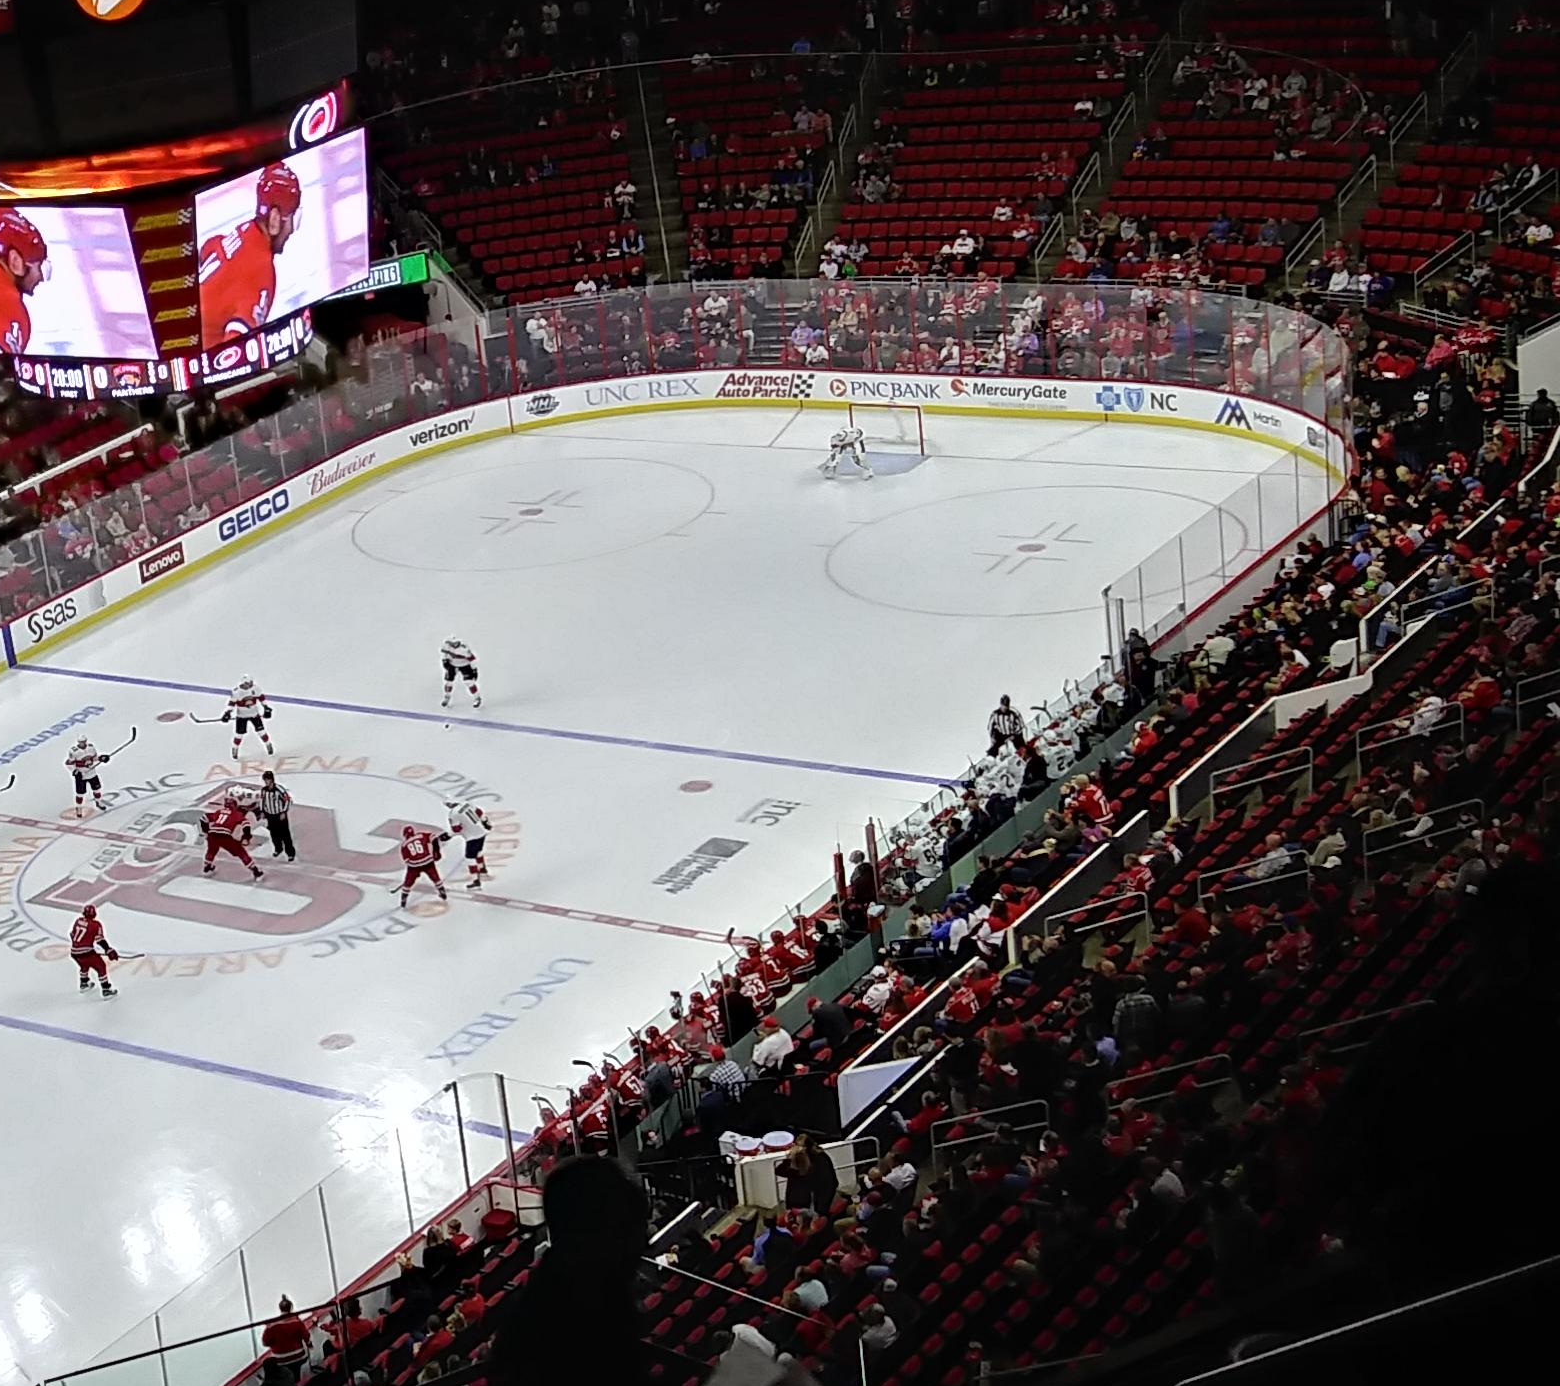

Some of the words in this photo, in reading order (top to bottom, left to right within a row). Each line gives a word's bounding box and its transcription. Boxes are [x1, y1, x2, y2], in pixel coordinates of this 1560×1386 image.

[245, 338, 260, 362] 0
[93, 366, 108, 389] 0
[724, 373, 790, 387] Advance
[585, 383, 640, 406] UNC
[647, 377, 701, 399] REX
[714, 387, 751, 399] Auto
[751, 386, 790, 399] Parts
[973, 382, 1068, 401] MercuryGate
[1151, 392, 1178, 412] NC
[409, 417, 470, 447] verizon
[1253, 411, 1282, 428] Martin
[307, 452, 376, 496] Budweiser
[219, 488, 289, 542] GEICO
[143, 549, 181, 577] Lenovo
[205, 755, 371, 781] ARENA
[103, 773, 185, 808] PNC
[427, 771, 503, 803] PNC
[128, 813, 162, 833] EST
[90, 844, 128, 871] 1997
[311, 916, 419, 959] PNC
[500, 958, 594, 1011] UNC
[426, 1012, 519, 1066] REX
